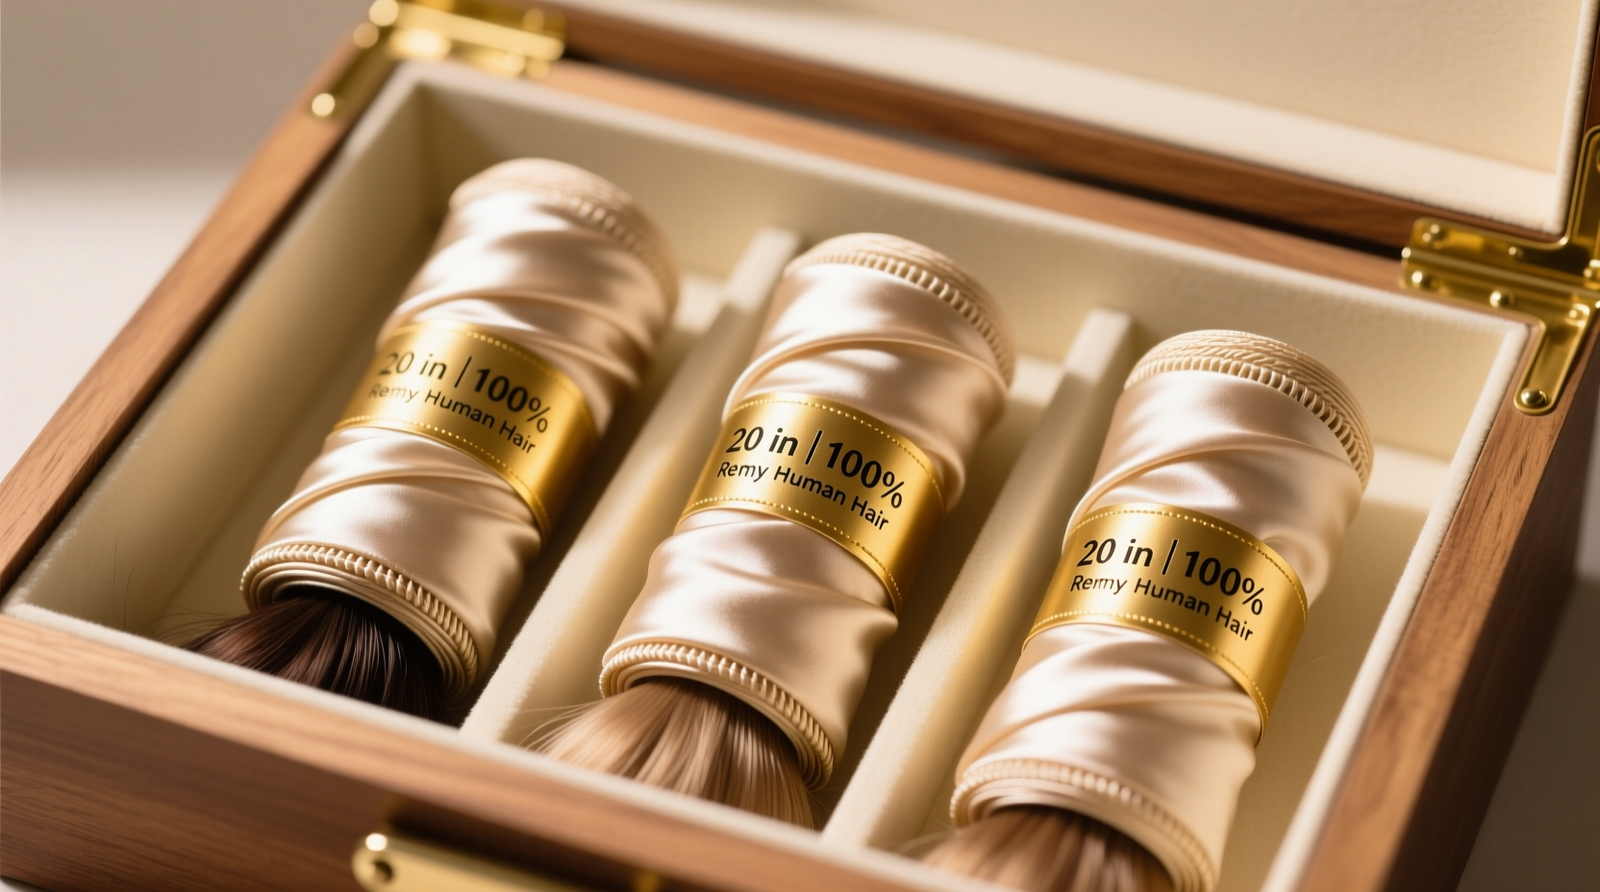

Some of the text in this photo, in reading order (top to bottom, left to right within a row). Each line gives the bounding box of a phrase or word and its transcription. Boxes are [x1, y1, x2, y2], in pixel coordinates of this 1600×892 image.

[378, 352, 414, 375] 20
[419, 353, 447, 380] in
[474, 368, 551, 433] 100%
[425, 389, 495, 429] Human
[499, 420, 536, 454] Hair
[717, 461, 889, 530] Remy Human Hair
[726, 426, 764, 453] 20
[768, 428, 799, 457] in
[826, 442, 905, 509] 100%
[1077, 538, 1116, 567] 20
[1123, 538, 1154, 567] in
[1184, 551, 1265, 616] 100%
[1134, 578, 1210, 617] Human
[1215, 606, 1253, 641] Hair
